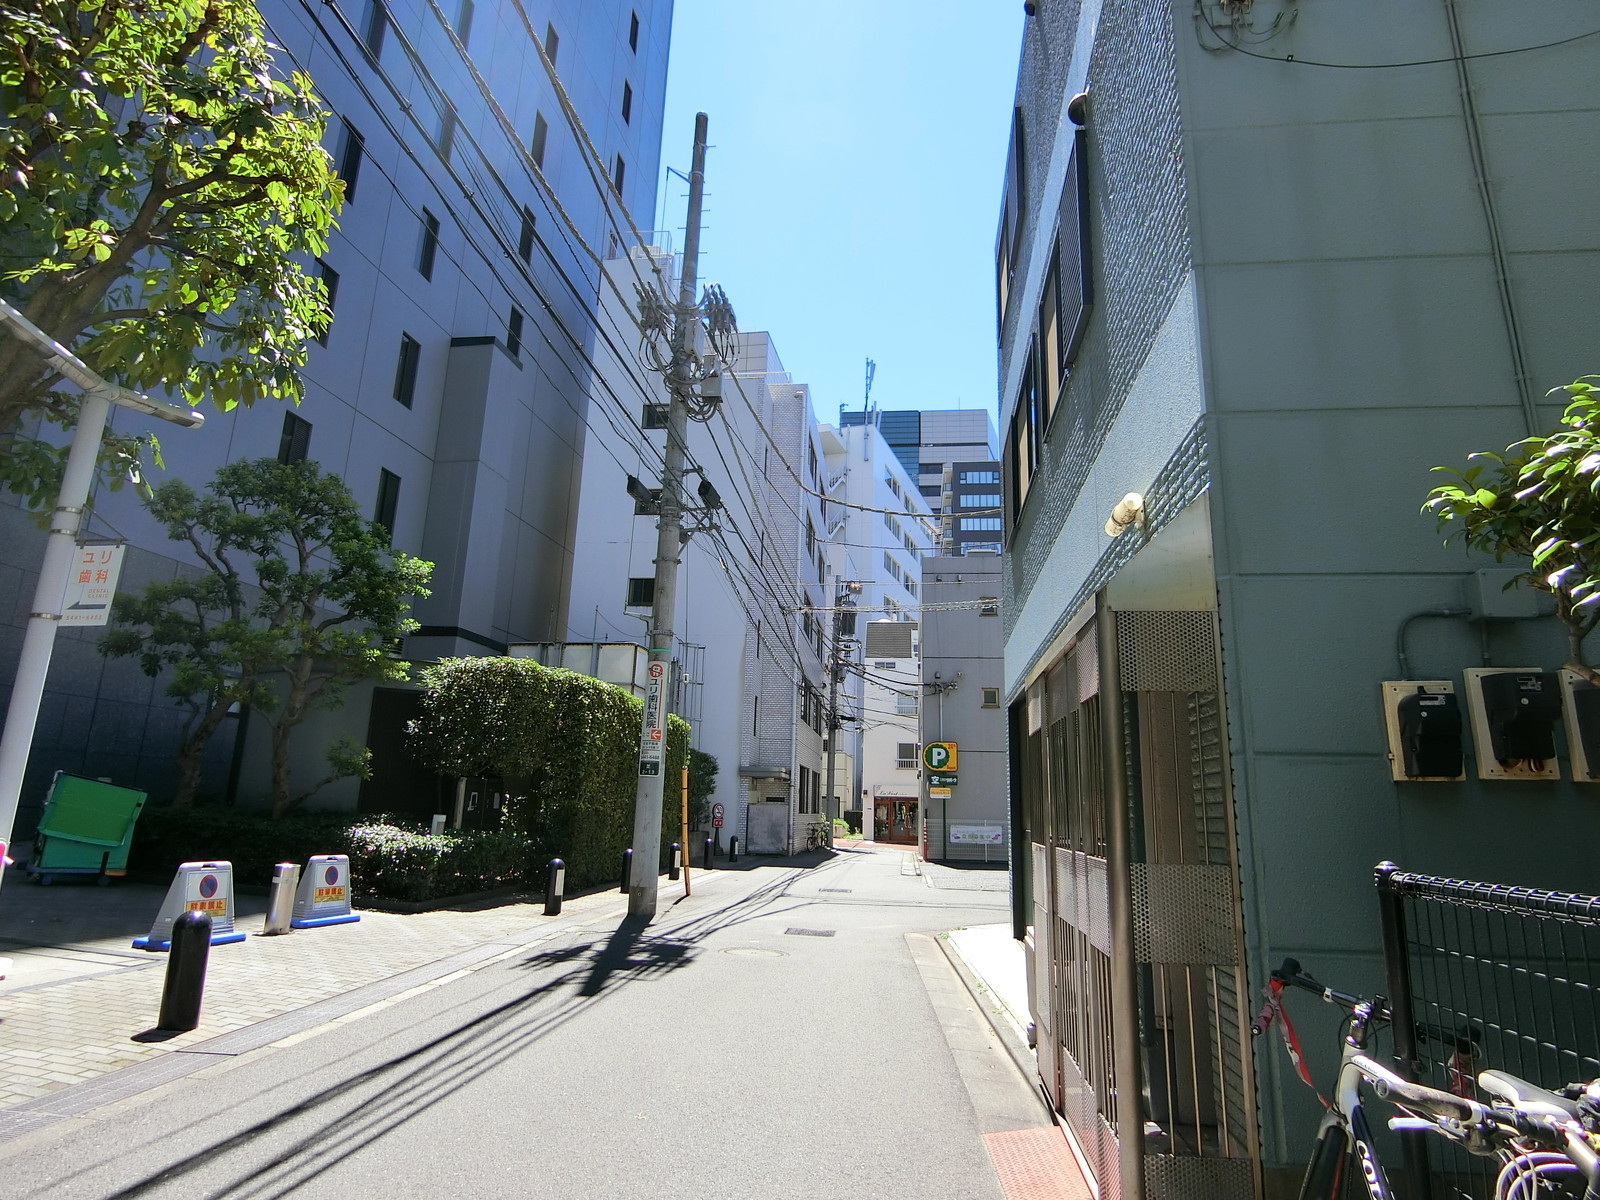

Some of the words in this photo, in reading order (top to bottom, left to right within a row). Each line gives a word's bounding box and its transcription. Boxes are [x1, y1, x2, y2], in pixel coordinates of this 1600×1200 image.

[83, 551, 112, 564] ユリ
[79, 569, 108, 583] 歯科
[646, 679, 659, 728] ユリ歯科医院
[932, 748, 946, 766] P
